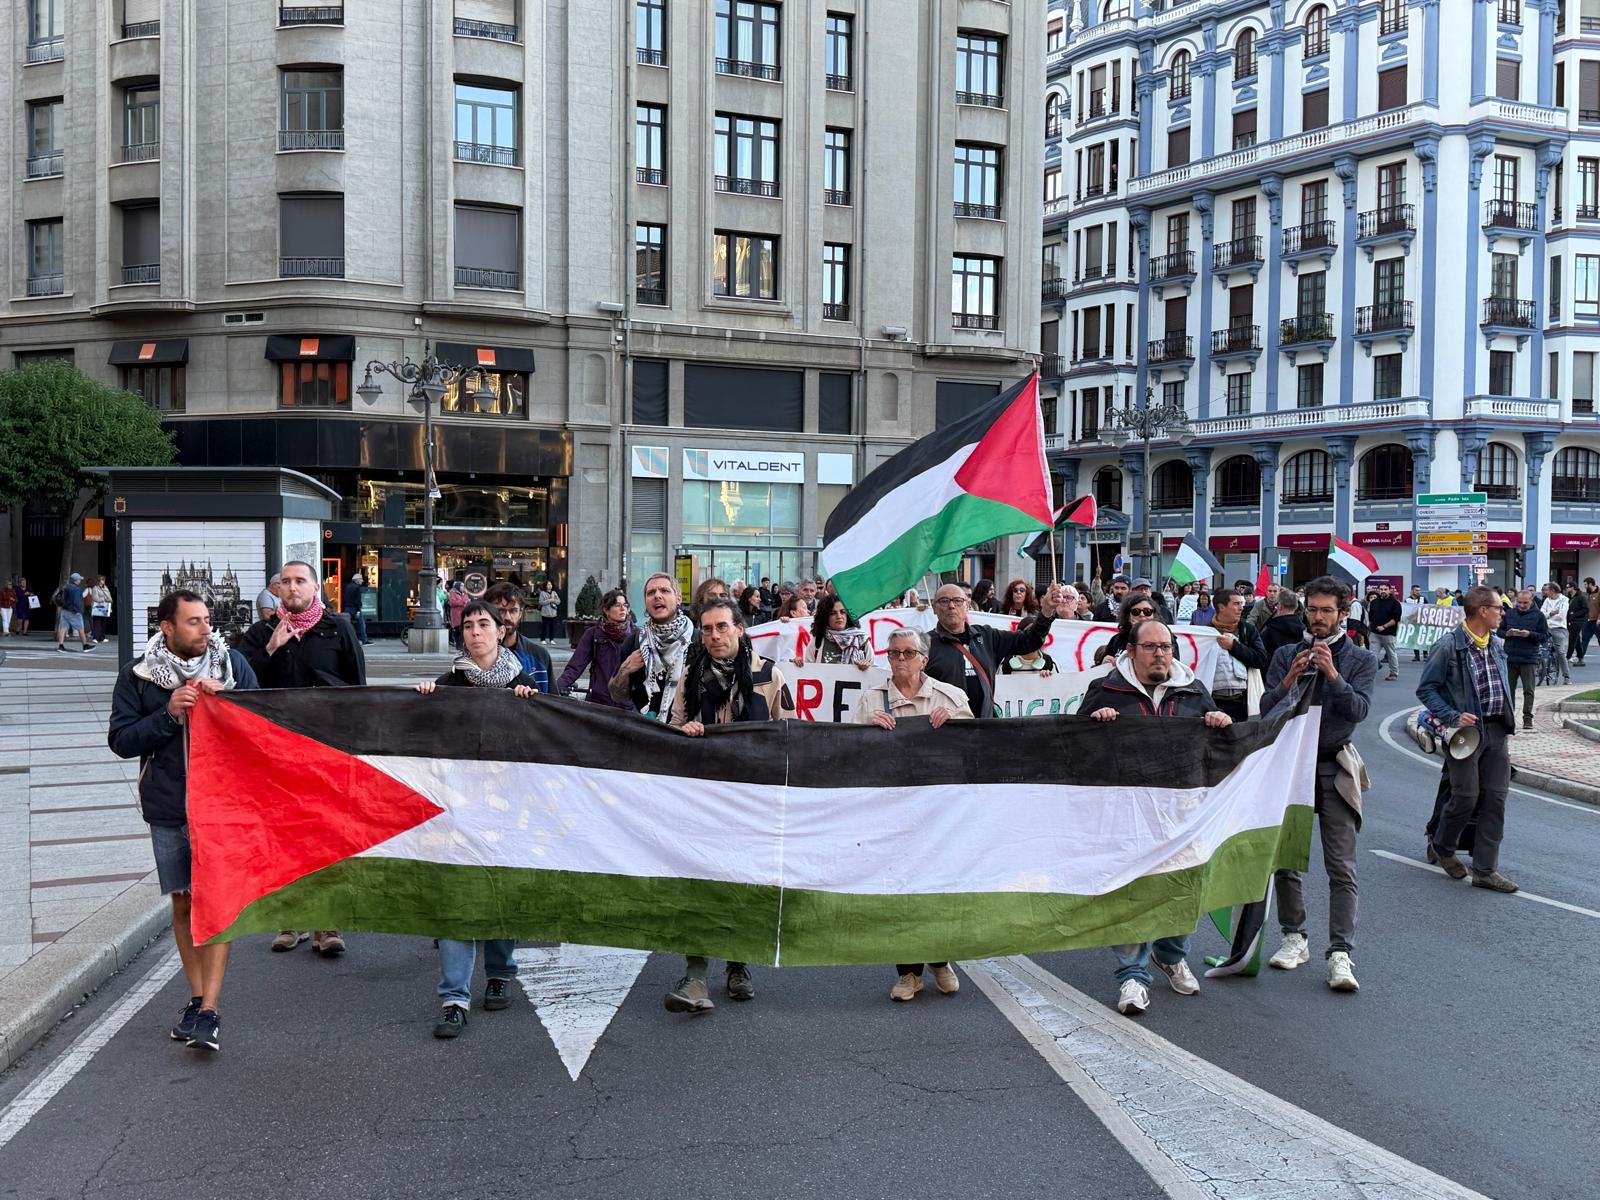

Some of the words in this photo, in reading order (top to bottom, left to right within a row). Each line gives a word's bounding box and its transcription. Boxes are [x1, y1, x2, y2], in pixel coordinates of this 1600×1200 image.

[713, 460, 800, 472] VITALDENT
[1417, 607, 1459, 627] ISRAEL:
[1396, 623, 1416, 644] OP
